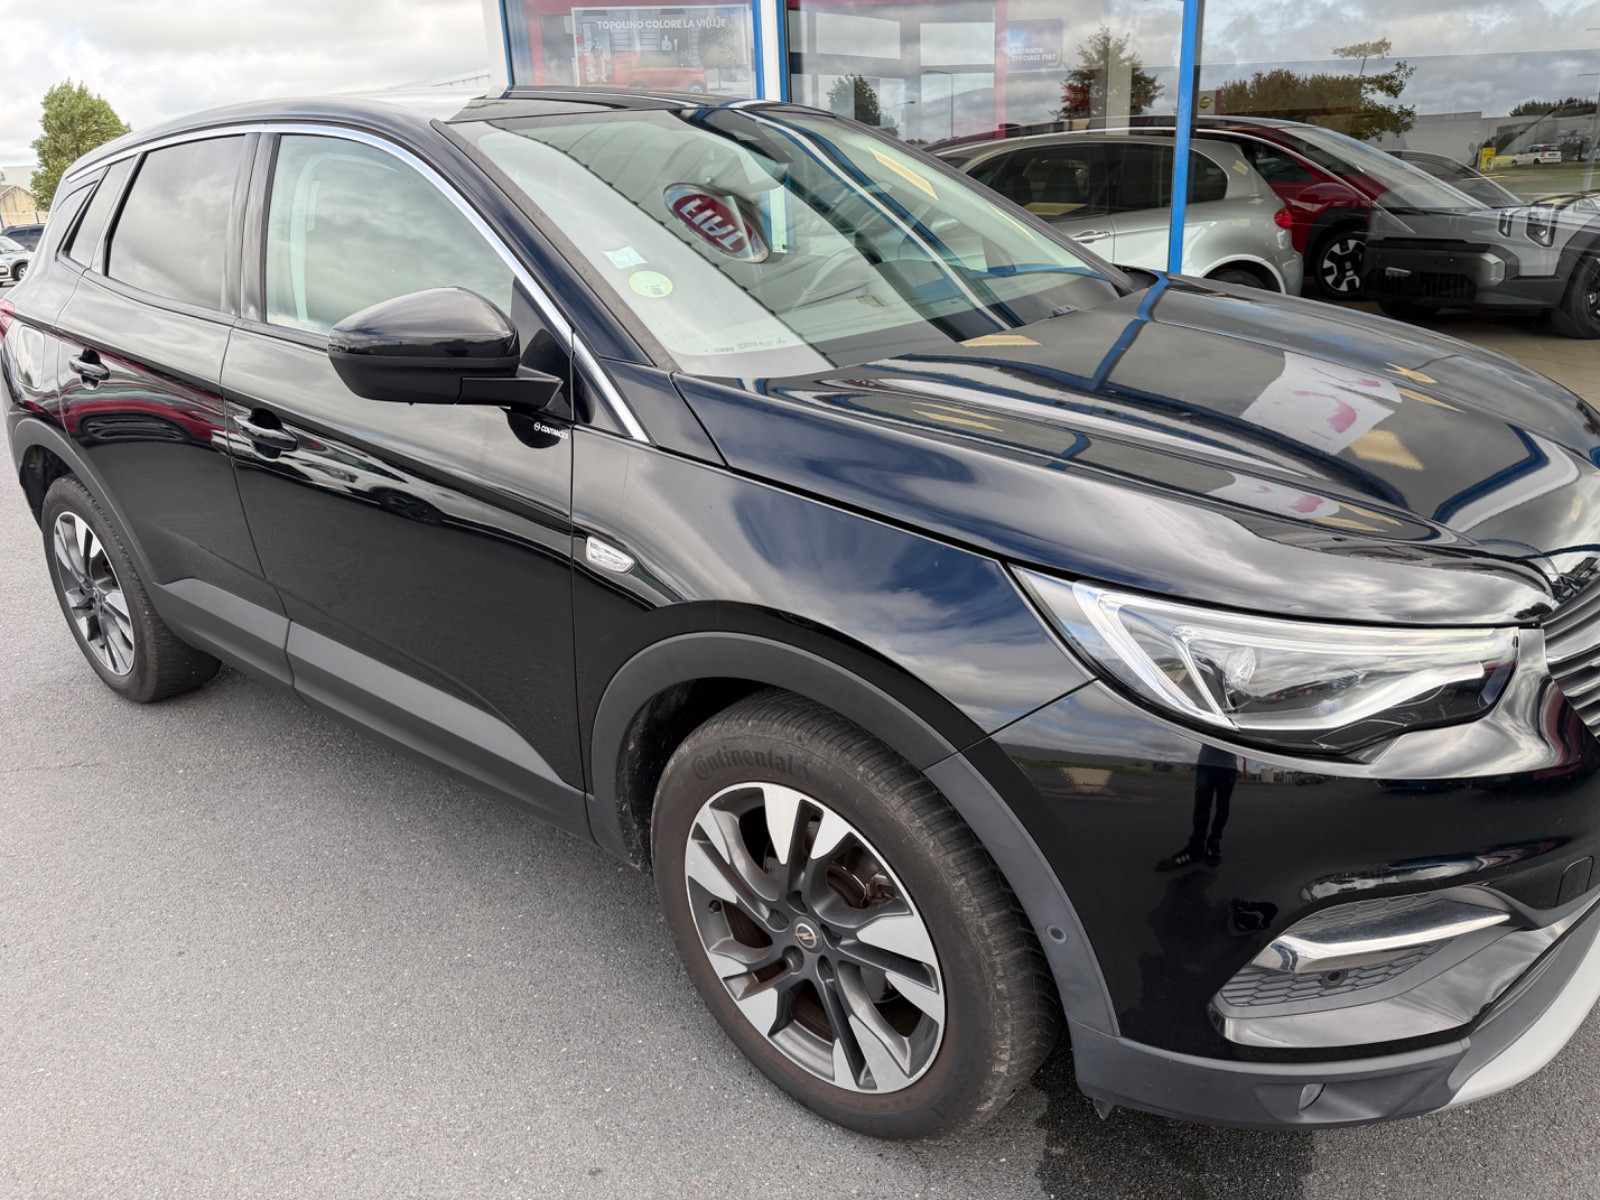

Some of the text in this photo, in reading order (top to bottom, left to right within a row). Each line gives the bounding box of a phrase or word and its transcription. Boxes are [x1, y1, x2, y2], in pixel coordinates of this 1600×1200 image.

[597, 20, 644, 29] TOPOLINO
[645, 19, 683, 29] COLORE
[683, 18, 694, 28] LA
[692, 746, 793, 780] Continental
